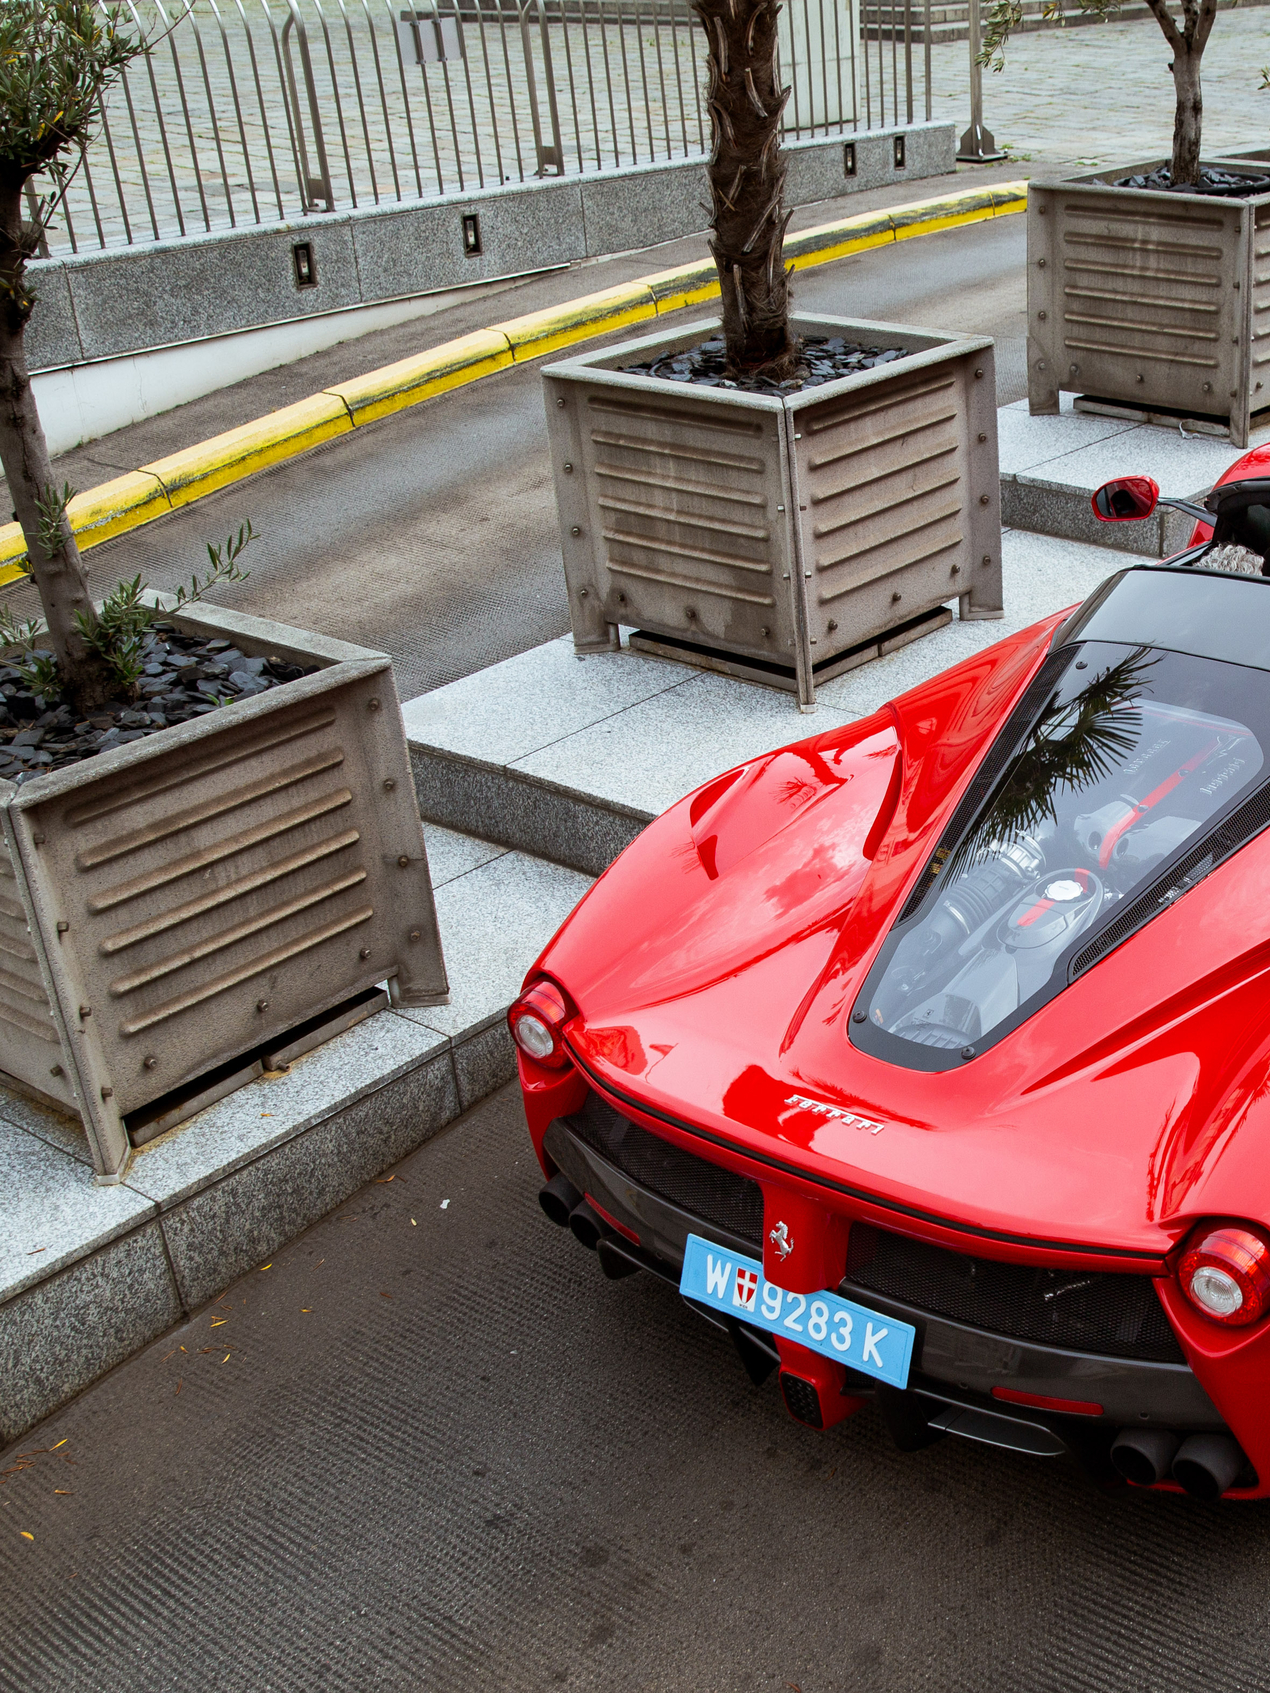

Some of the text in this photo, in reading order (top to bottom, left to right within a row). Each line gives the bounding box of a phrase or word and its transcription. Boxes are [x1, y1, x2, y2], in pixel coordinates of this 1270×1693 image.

[783, 1093, 885, 1135] Ferrari
[706, 1254, 888, 1368] W 9283 K
